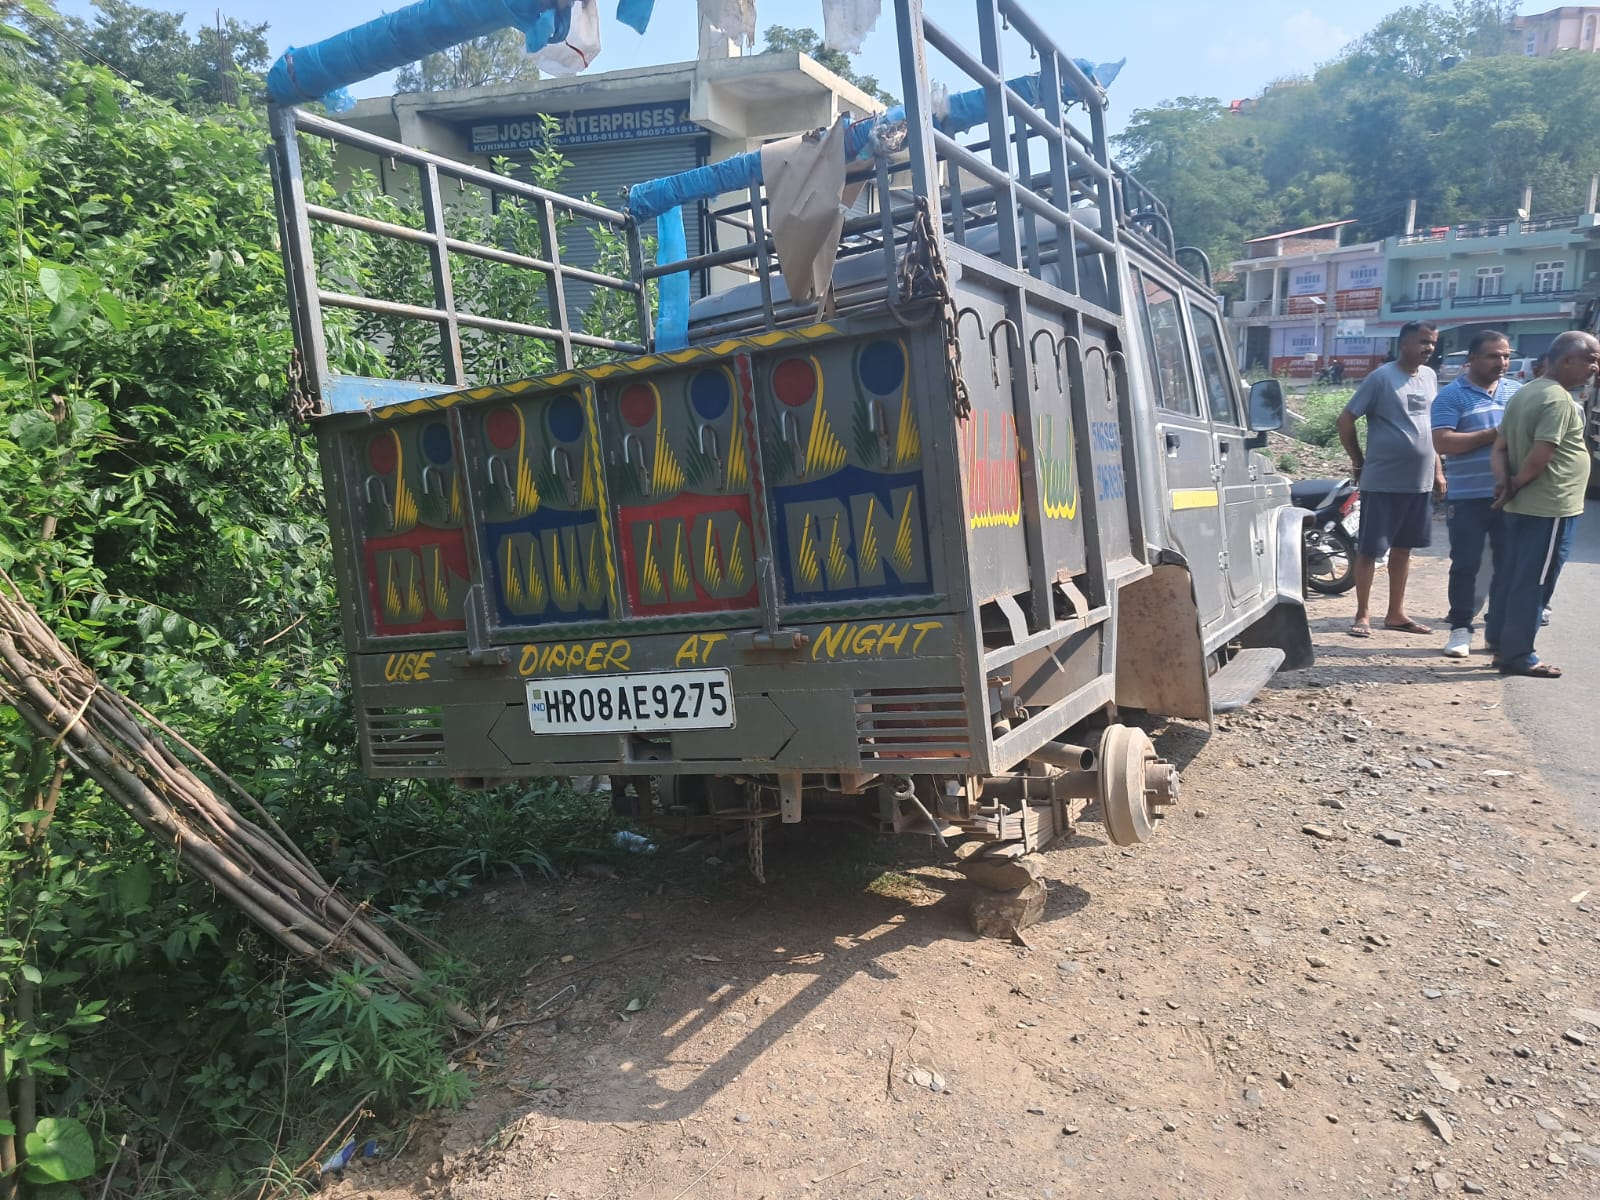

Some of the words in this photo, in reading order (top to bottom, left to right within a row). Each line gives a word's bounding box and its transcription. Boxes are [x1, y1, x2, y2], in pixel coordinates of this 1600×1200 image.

[384, 652, 436, 682] USE
[518, 639, 631, 676] DIPPER
[675, 633, 728, 667] AT
[811, 622, 943, 661] NIGHT
[531, 702, 546, 712] IND
[543, 681, 728, 723] HR08AE9275
